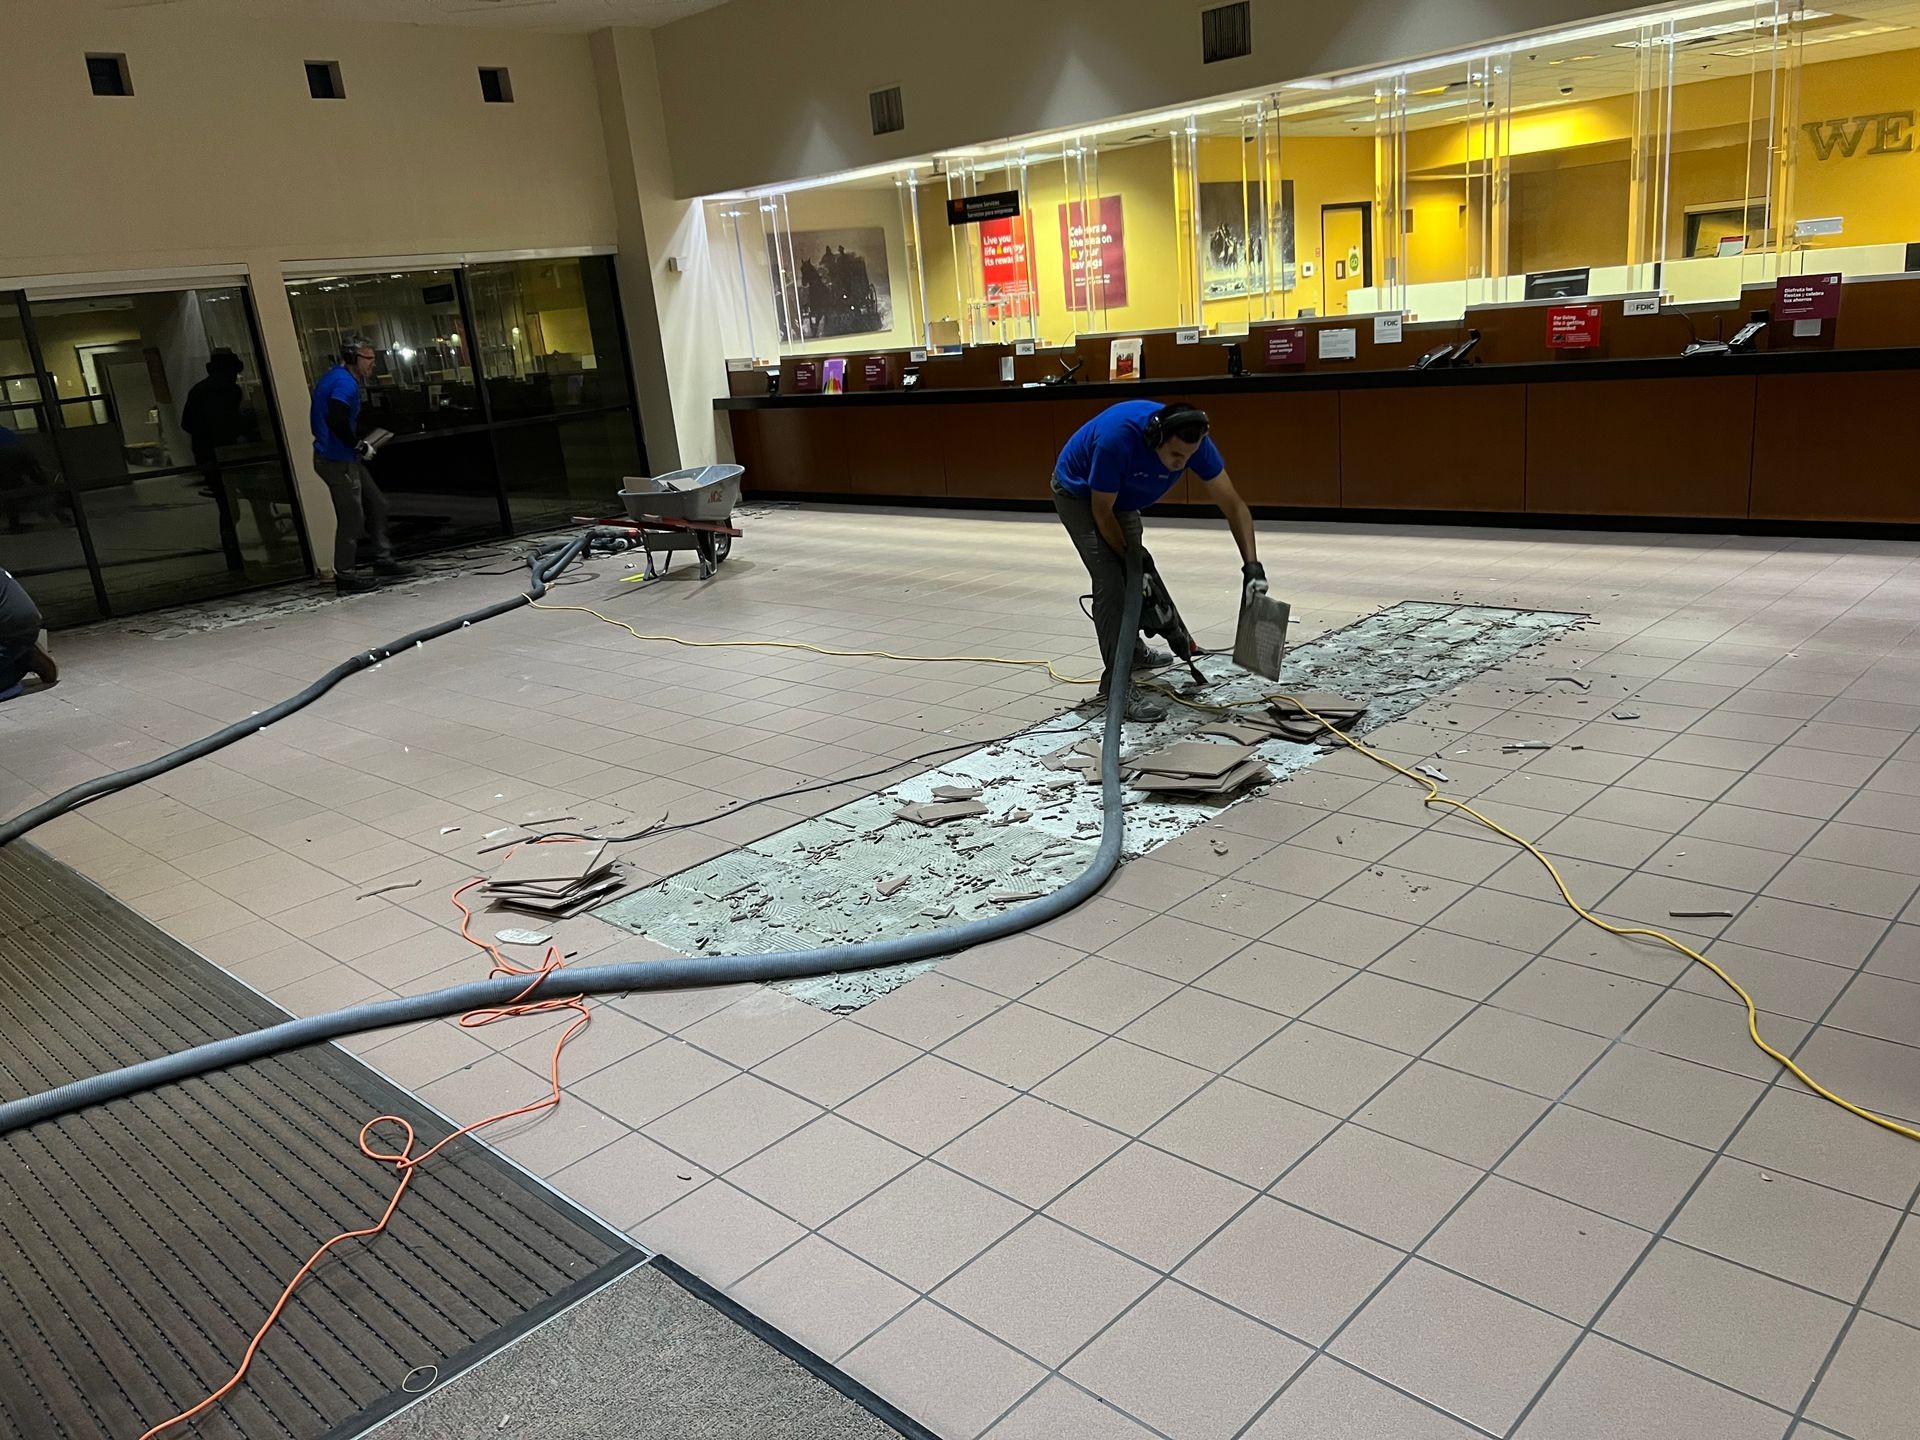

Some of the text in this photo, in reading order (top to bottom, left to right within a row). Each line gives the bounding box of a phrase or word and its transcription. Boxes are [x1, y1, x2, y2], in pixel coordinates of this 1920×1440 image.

[983, 236, 998, 246] Live
[984, 246, 996, 256] life
[996, 246, 1002, 254] &
[984, 257, 994, 267] its
